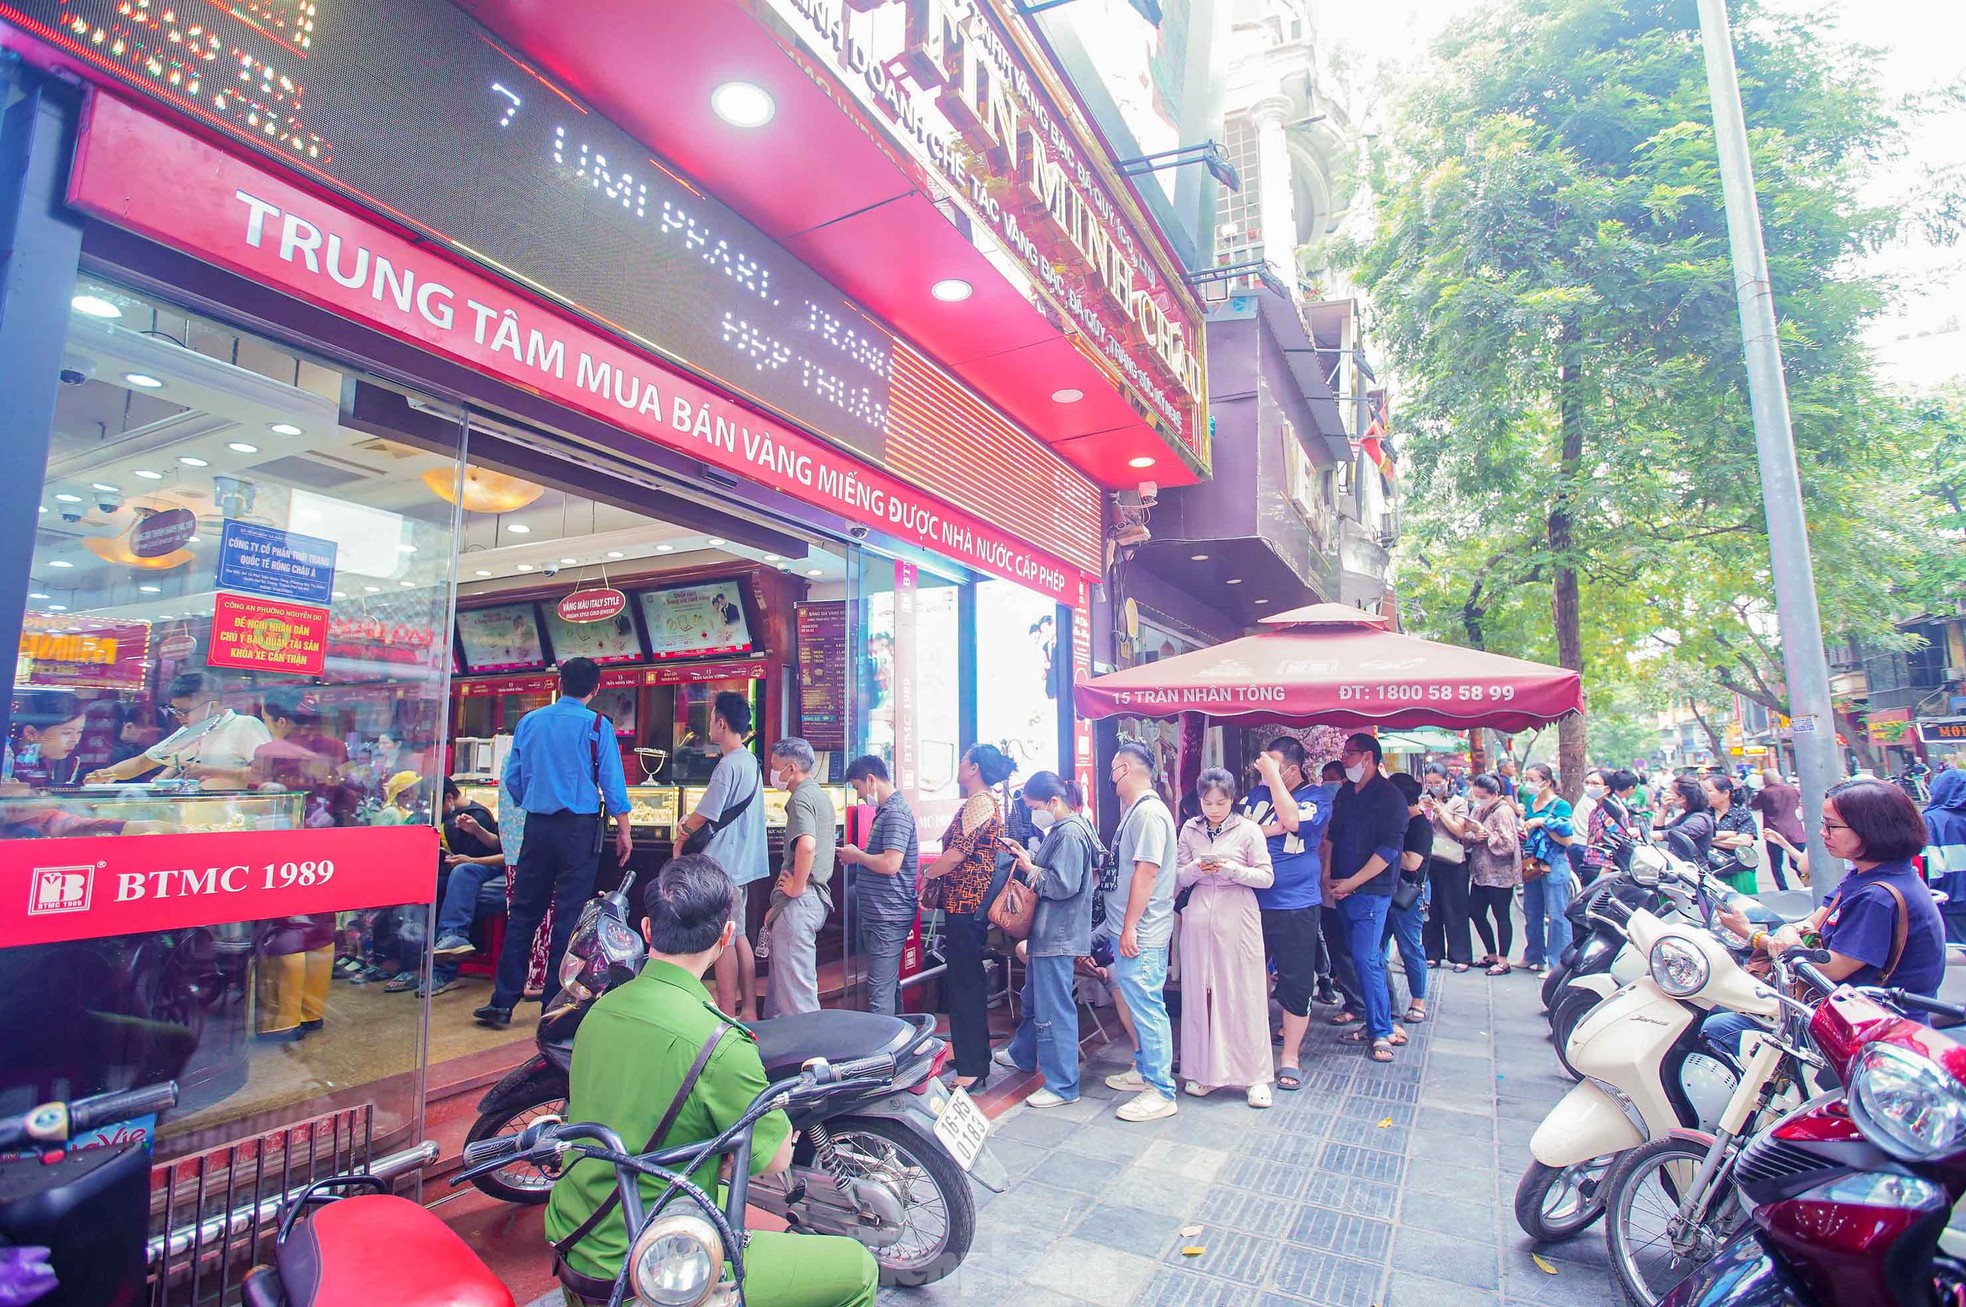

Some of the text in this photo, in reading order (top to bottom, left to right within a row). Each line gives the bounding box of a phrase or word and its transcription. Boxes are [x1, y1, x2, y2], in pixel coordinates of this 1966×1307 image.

[1029, 125, 1135, 321] MINH
[236, 189, 455, 330] TRUNG
[467, 299, 566, 379] TÂM
[576, 352, 663, 423] MUA
[672, 396, 736, 453] BÁN
[742, 427, 813, 486] VÀNG
[818, 464, 884, 517] MIẾNG
[888, 498, 938, 540] ĐƯỢC
[942, 523, 973, 552] NHÀ
[976, 537, 1013, 570] NƯỚC
[1015, 554, 1037, 584] CẤP
[1039, 568, 1065, 593] PHÉP
[250, 542, 260, 552] TY
[224, 601, 245, 610] CÔNG
[590, 597, 603, 608] ITALY
[603, 596, 620, 607] STYLE
[254, 650, 267, 661] XE
[1112, 685, 1285, 704] 15 TRẦN NHÂN TÔNG
[1339, 685, 1515, 701] ĐT: 1800 58 58 99
[903, 714, 912, 764] BTMC
[114, 860, 335, 902] BTMC 1989
[38, 902, 60, 910] BTMC
[941, 1096, 971, 1139] 16-R5
[957, 1115, 986, 1160] 0183
